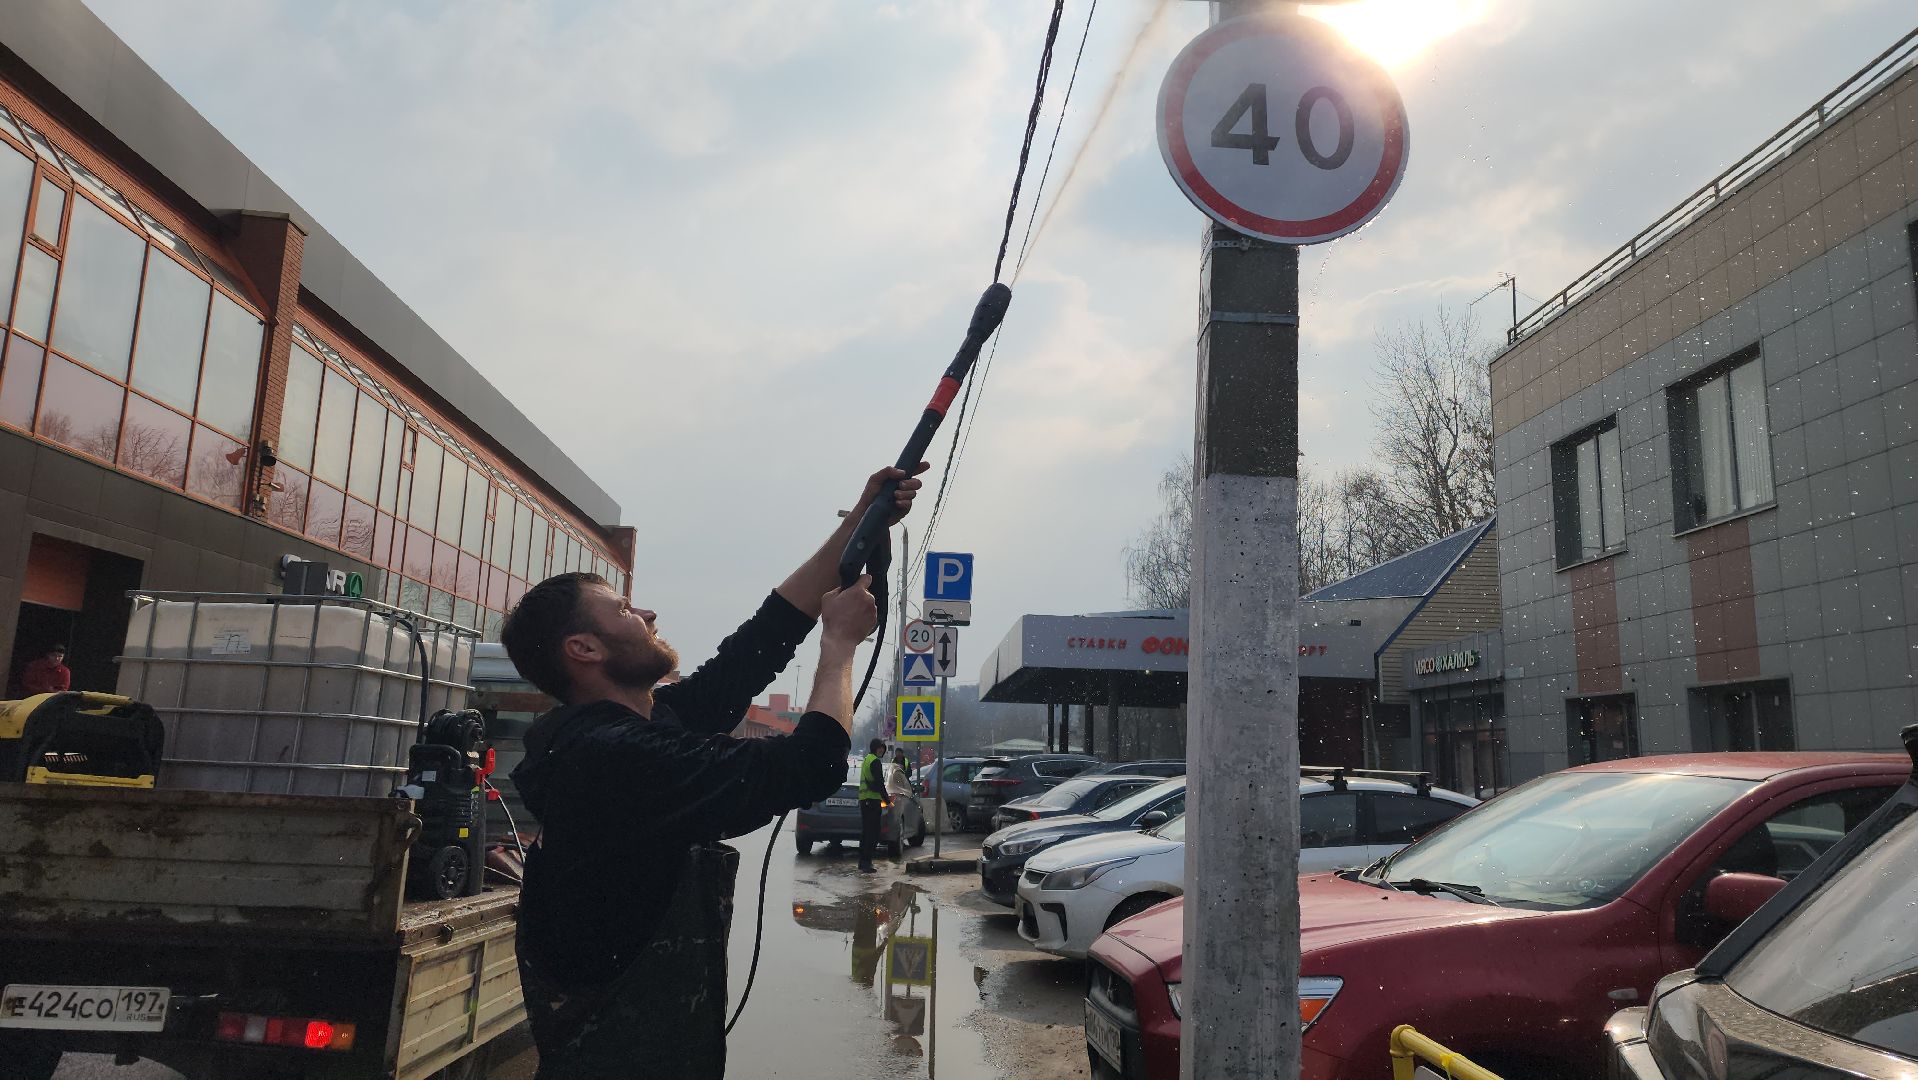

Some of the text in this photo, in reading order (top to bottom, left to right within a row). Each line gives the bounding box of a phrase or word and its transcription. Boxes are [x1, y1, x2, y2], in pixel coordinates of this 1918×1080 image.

[1211, 83, 1354, 170] 40
[937, 558, 964, 594] P
[911, 629, 930, 642] 20
[1067, 636, 1328, 656] СТАВКИ ФОН ОРТ
[1415, 649, 1475, 675] МЯСО ХАЛЯЛЬ
[11, 991, 160, 1019] Е424СО 197
